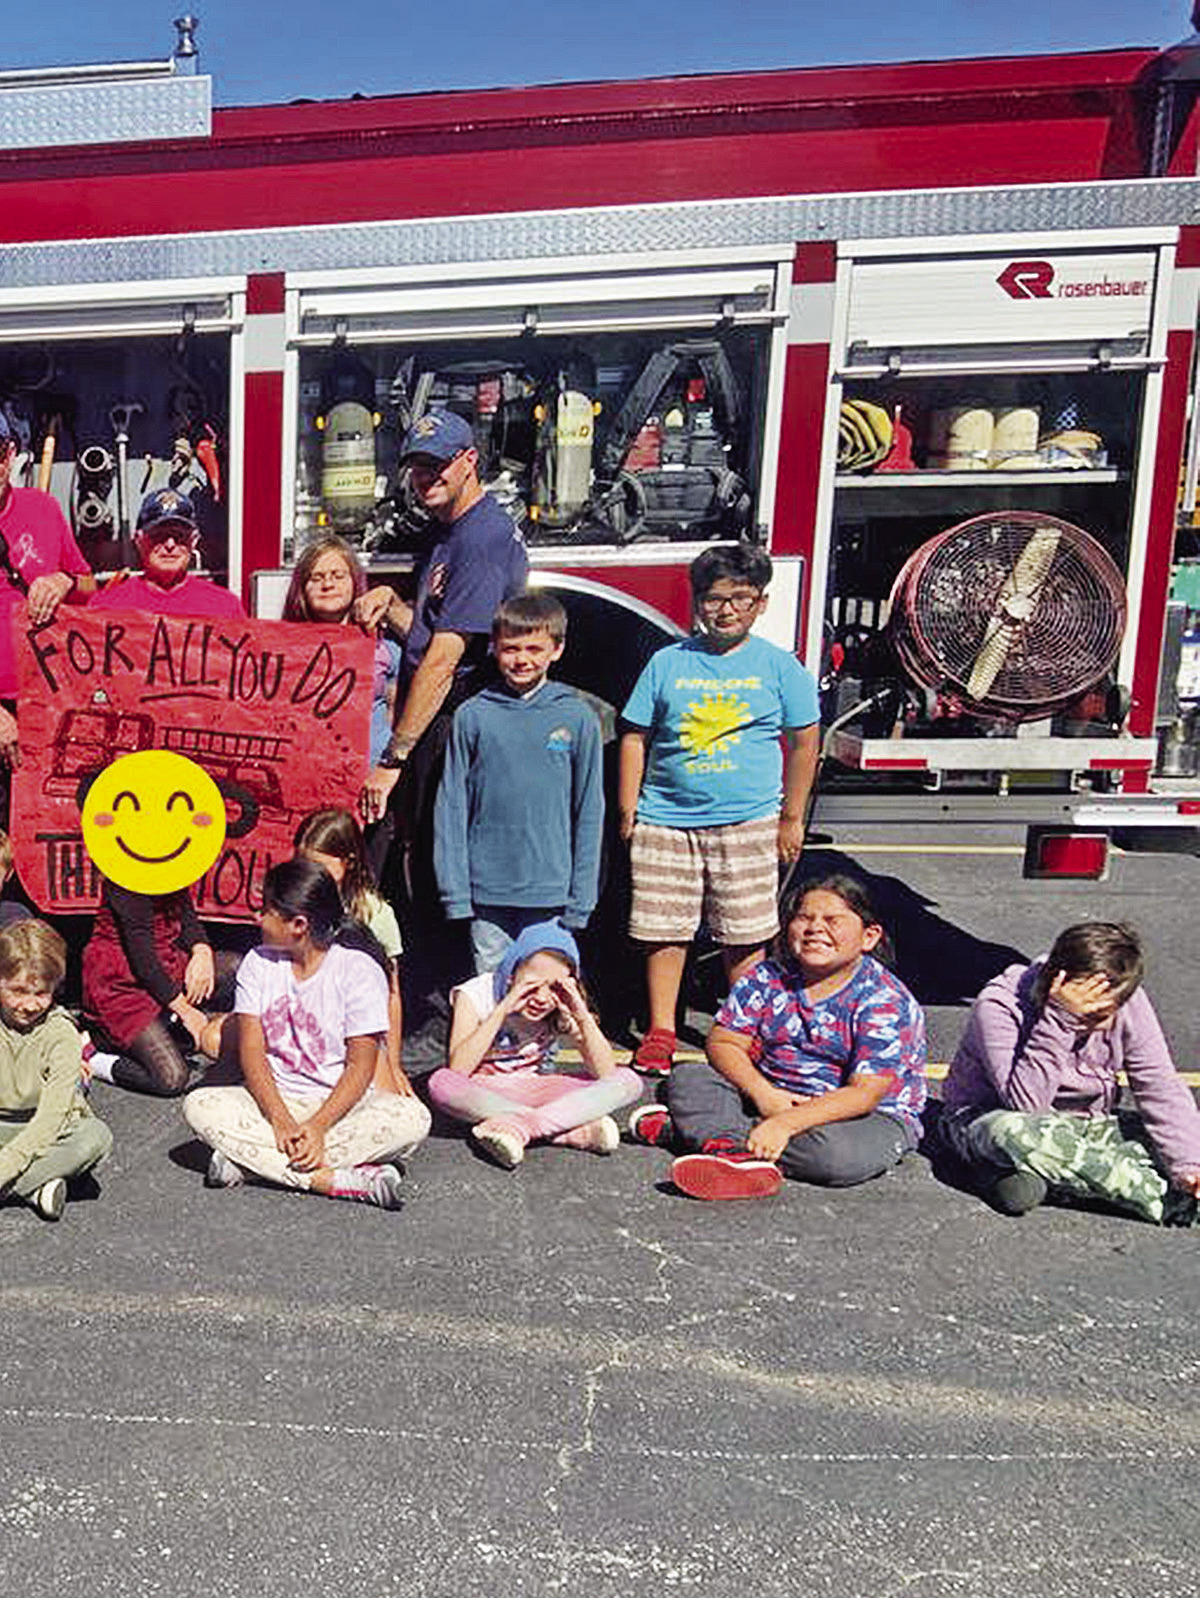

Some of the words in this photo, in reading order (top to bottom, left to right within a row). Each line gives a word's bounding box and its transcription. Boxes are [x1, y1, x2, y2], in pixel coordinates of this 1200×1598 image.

[1058, 274, 1148, 298] rosenbauer
[27, 618, 134, 694] FOR
[145, 617, 219, 687] ALL
[217, 634, 285, 701] YOU
[290, 641, 358, 720] DO
